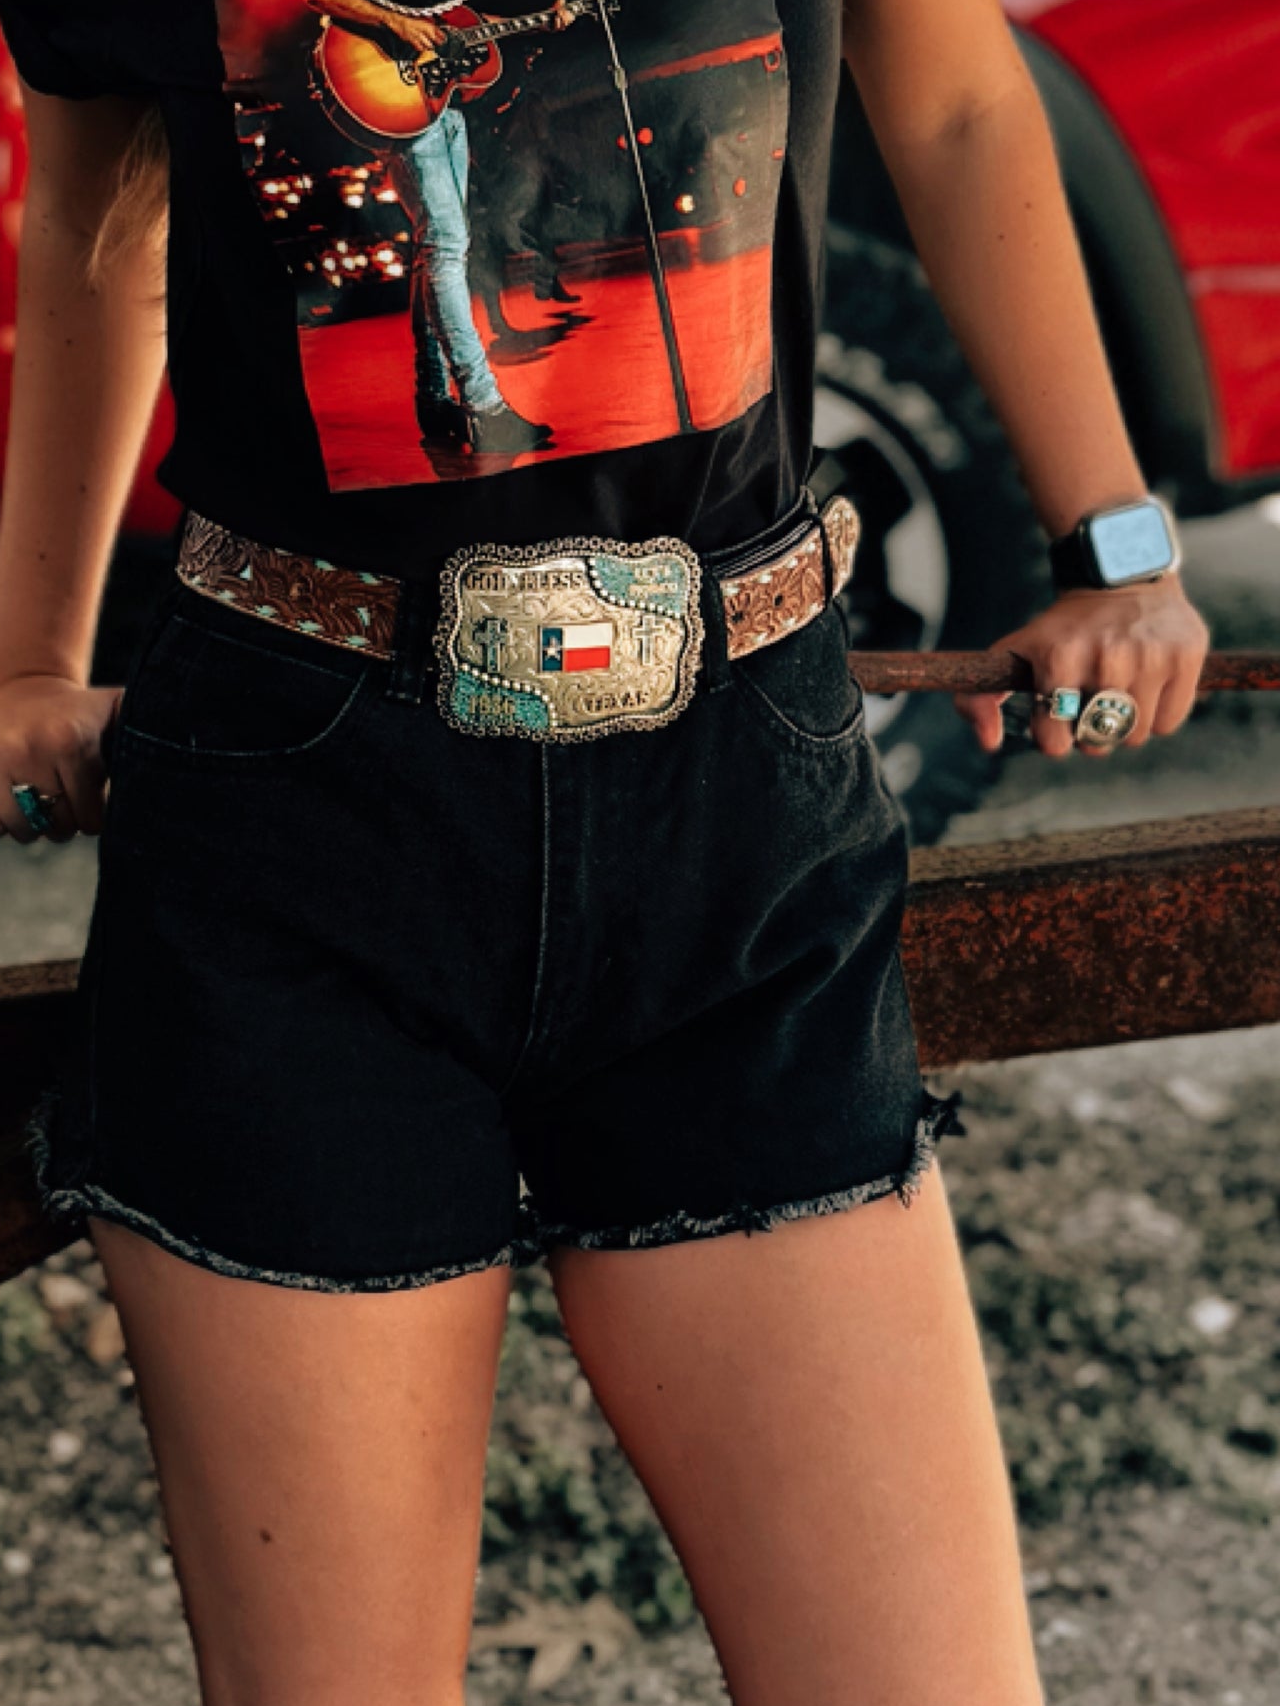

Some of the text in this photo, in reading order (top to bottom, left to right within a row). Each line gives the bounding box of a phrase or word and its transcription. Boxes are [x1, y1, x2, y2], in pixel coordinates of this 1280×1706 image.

[467, 571, 583, 591] GOD BLESS
[585, 691, 650, 712] TEXAS
